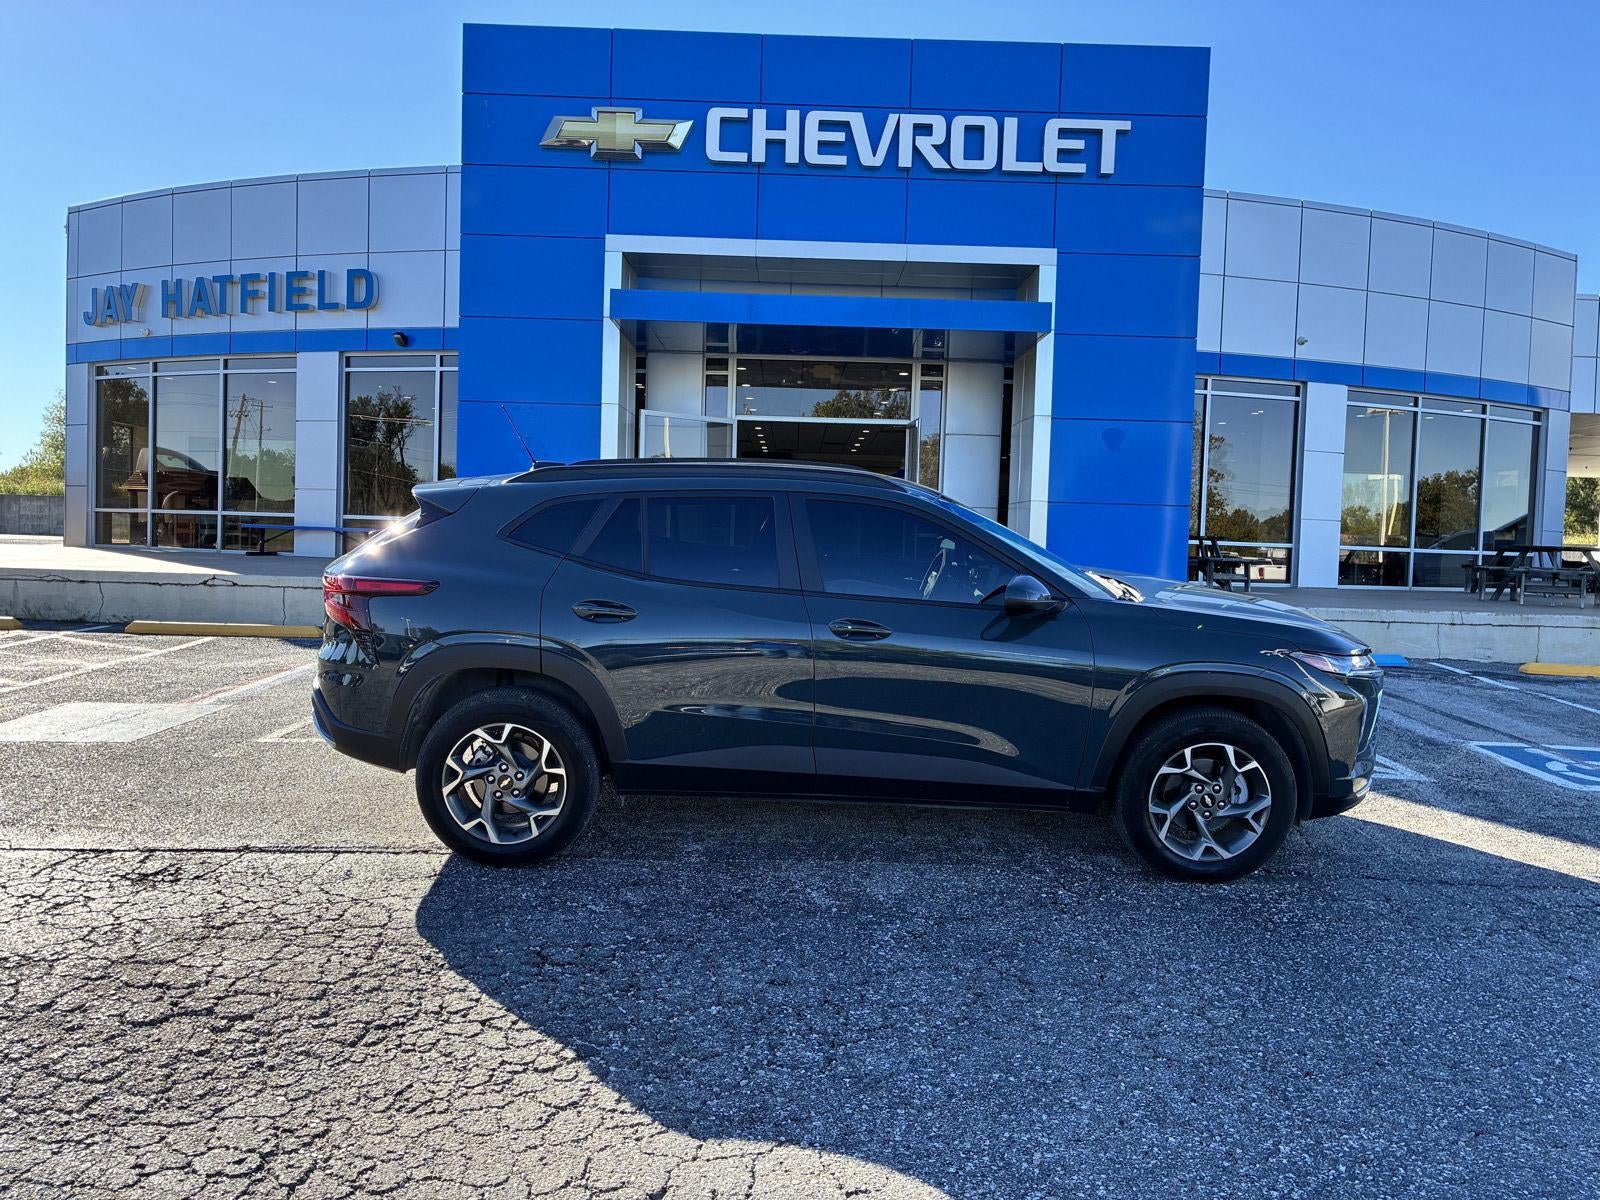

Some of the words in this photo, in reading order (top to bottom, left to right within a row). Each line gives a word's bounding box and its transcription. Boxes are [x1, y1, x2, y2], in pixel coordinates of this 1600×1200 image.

[705, 106, 1132, 175] CHEVROLET
[83, 282, 144, 327] JAY
[161, 268, 379, 319] HATFIELD
